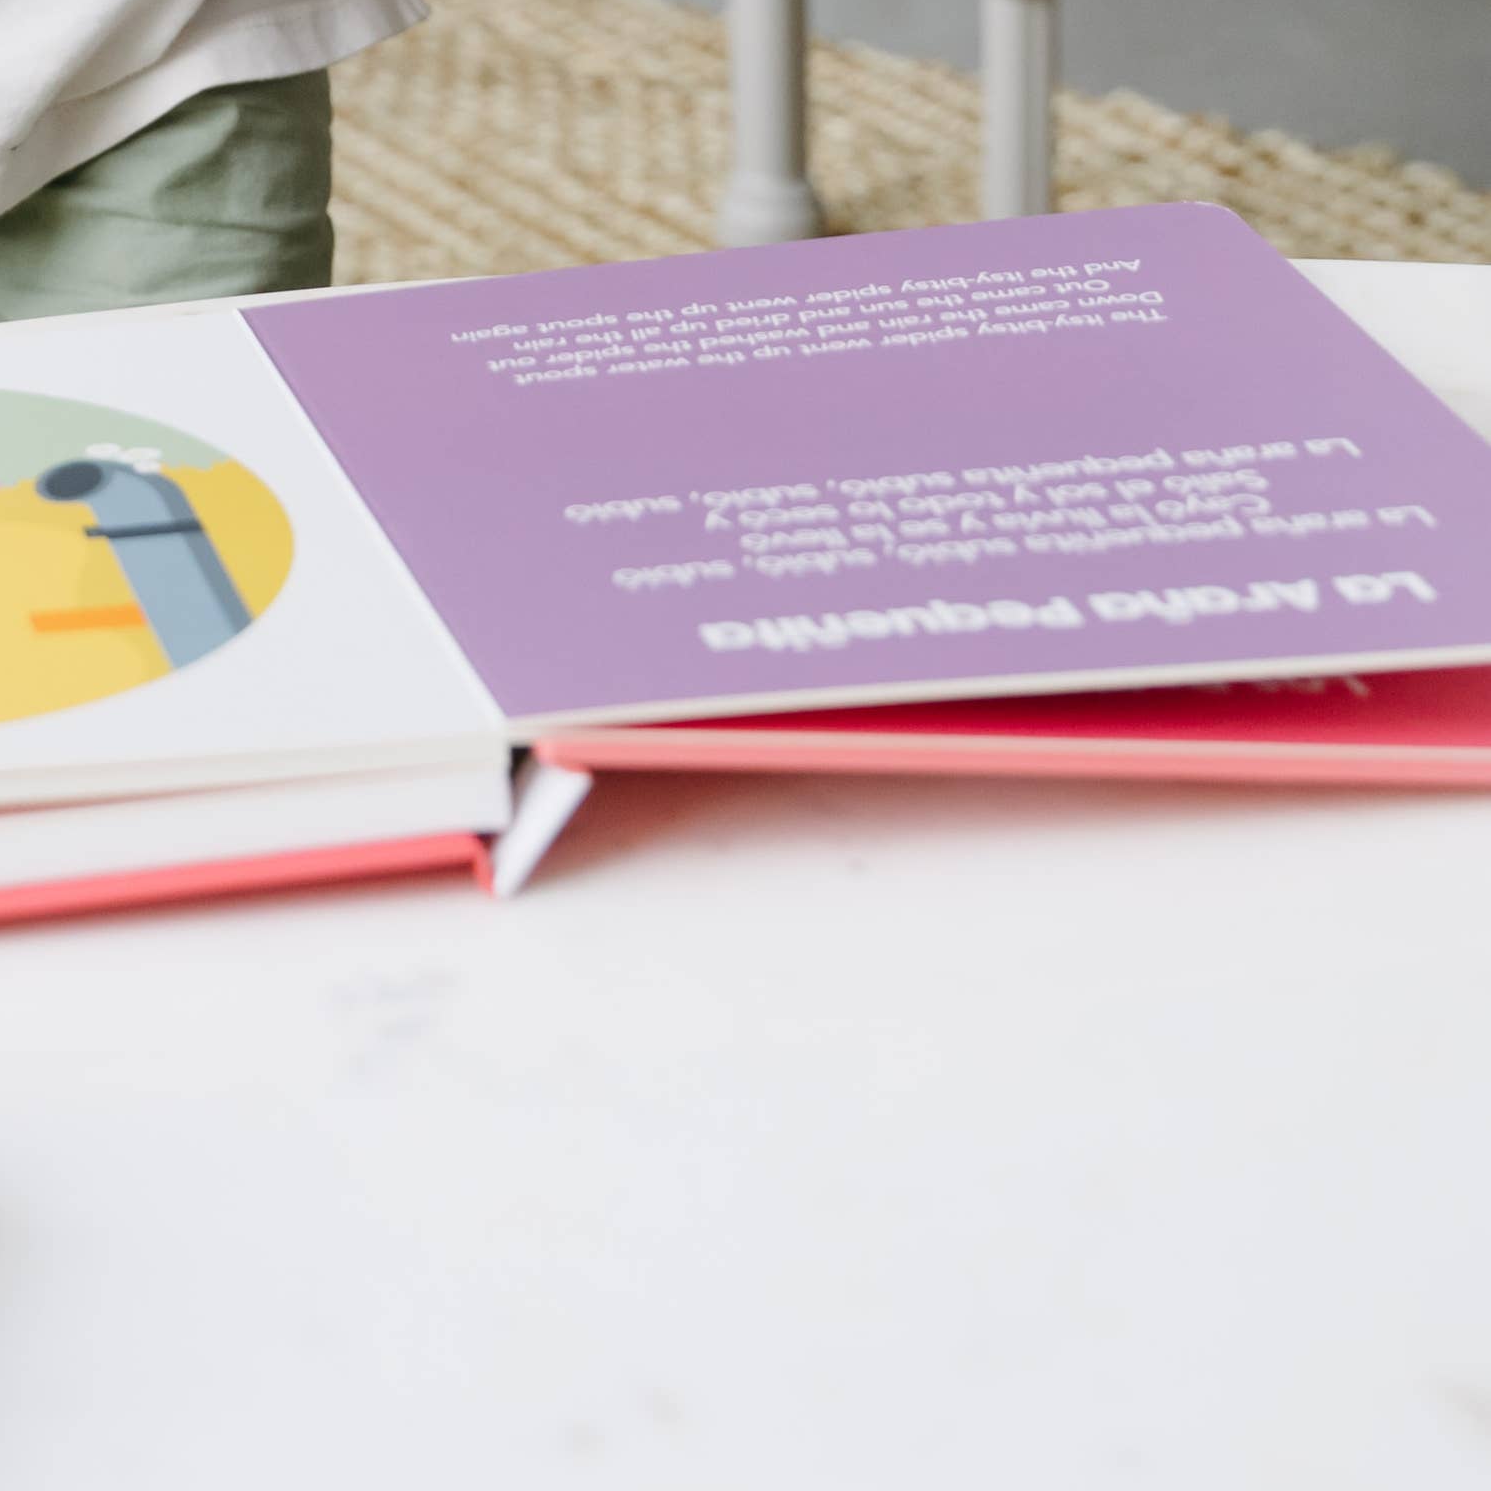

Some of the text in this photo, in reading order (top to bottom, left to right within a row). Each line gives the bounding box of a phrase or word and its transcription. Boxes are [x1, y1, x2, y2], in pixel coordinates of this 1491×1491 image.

[1031, 265, 1077, 278] the
[1083, 259, 1140, 274] And
[805, 283, 892, 304] spider
[680, 303, 718, 316] up
[725, 295, 797, 314] went
[513, 279, 1110, 352] Out came the sun and dried up all the rain
[536, 313, 617, 333] spout
[626, 309, 673, 322] the
[1110, 307, 1166, 322] The
[450, 324, 528, 342] again
[487, 291, 1163, 371] Down came the rain and washed the spider out
[880, 326, 969, 347] spider
[752, 345, 791, 358] up
[799, 337, 872, 356] went
[607, 356, 690, 374] water
[697, 351, 745, 365] the
[514, 365, 598, 386] spout
[699, 571, 1438, 652] La Araña Pequeñita
